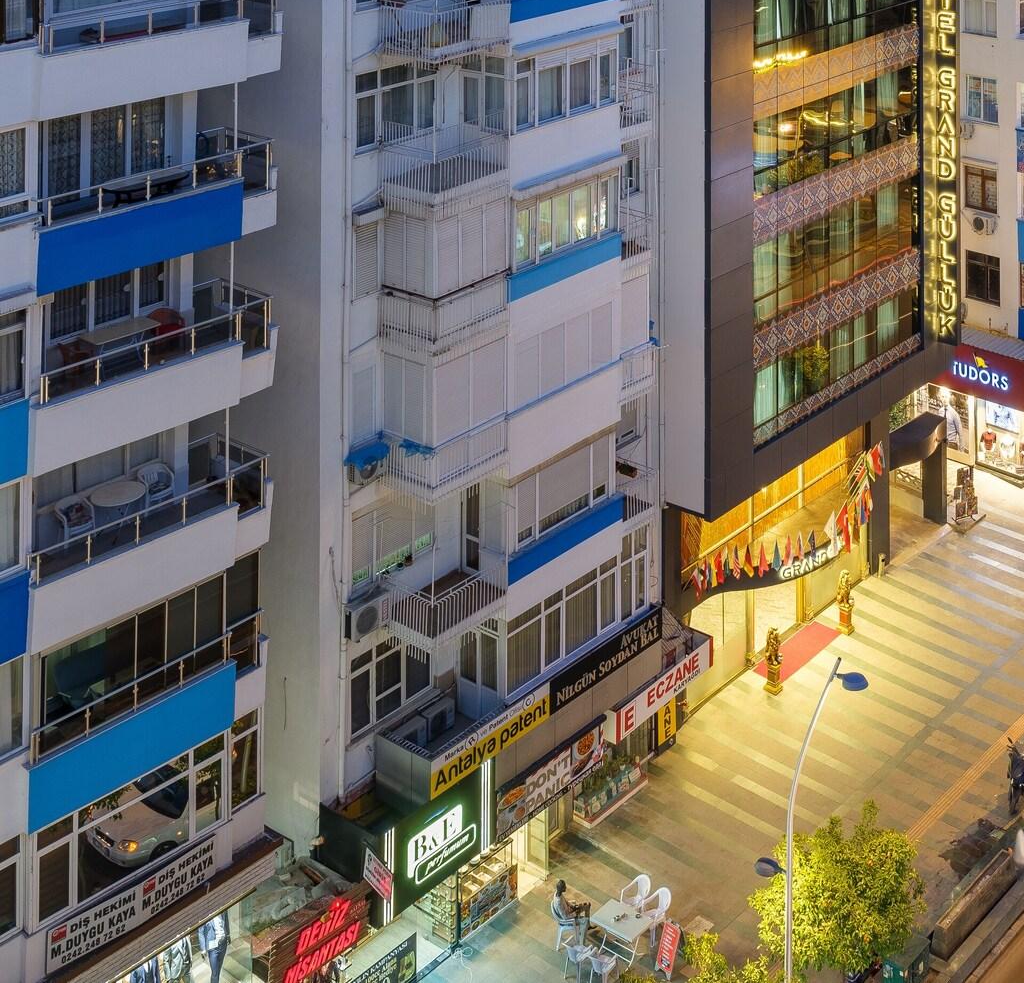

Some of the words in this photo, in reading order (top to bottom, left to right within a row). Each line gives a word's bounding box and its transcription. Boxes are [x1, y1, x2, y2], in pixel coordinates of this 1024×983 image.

[936, 68, 956, 180] GRAND
[953, 361, 1009, 391] TUDORS
[599, 641, 638, 676] SOYDAN
[640, 629, 660, 648] BAL
[620, 615, 660, 649] AVUKAT
[647, 652, 700, 708] ECZANE
[434, 736, 497, 792] Antalya
[500, 698, 548, 750] patent
[444, 745, 465, 763] Marka
[488, 713, 509, 731] Patent
[526, 754, 570, 796] DON'T
[526, 771, 570, 814] PANIC
[142, 873, 187, 911] M.DUYGU
[190, 855, 214, 879] KAYA
[158, 867, 176, 885] DİŞ
[178, 841, 214, 869] HEKİMİ
[51, 923, 104, 960] M.DUYGU
[108, 906, 136, 930] KAYA
[70, 916, 90, 934] DİŞ
[94, 890, 136, 922] HEKİMİ
